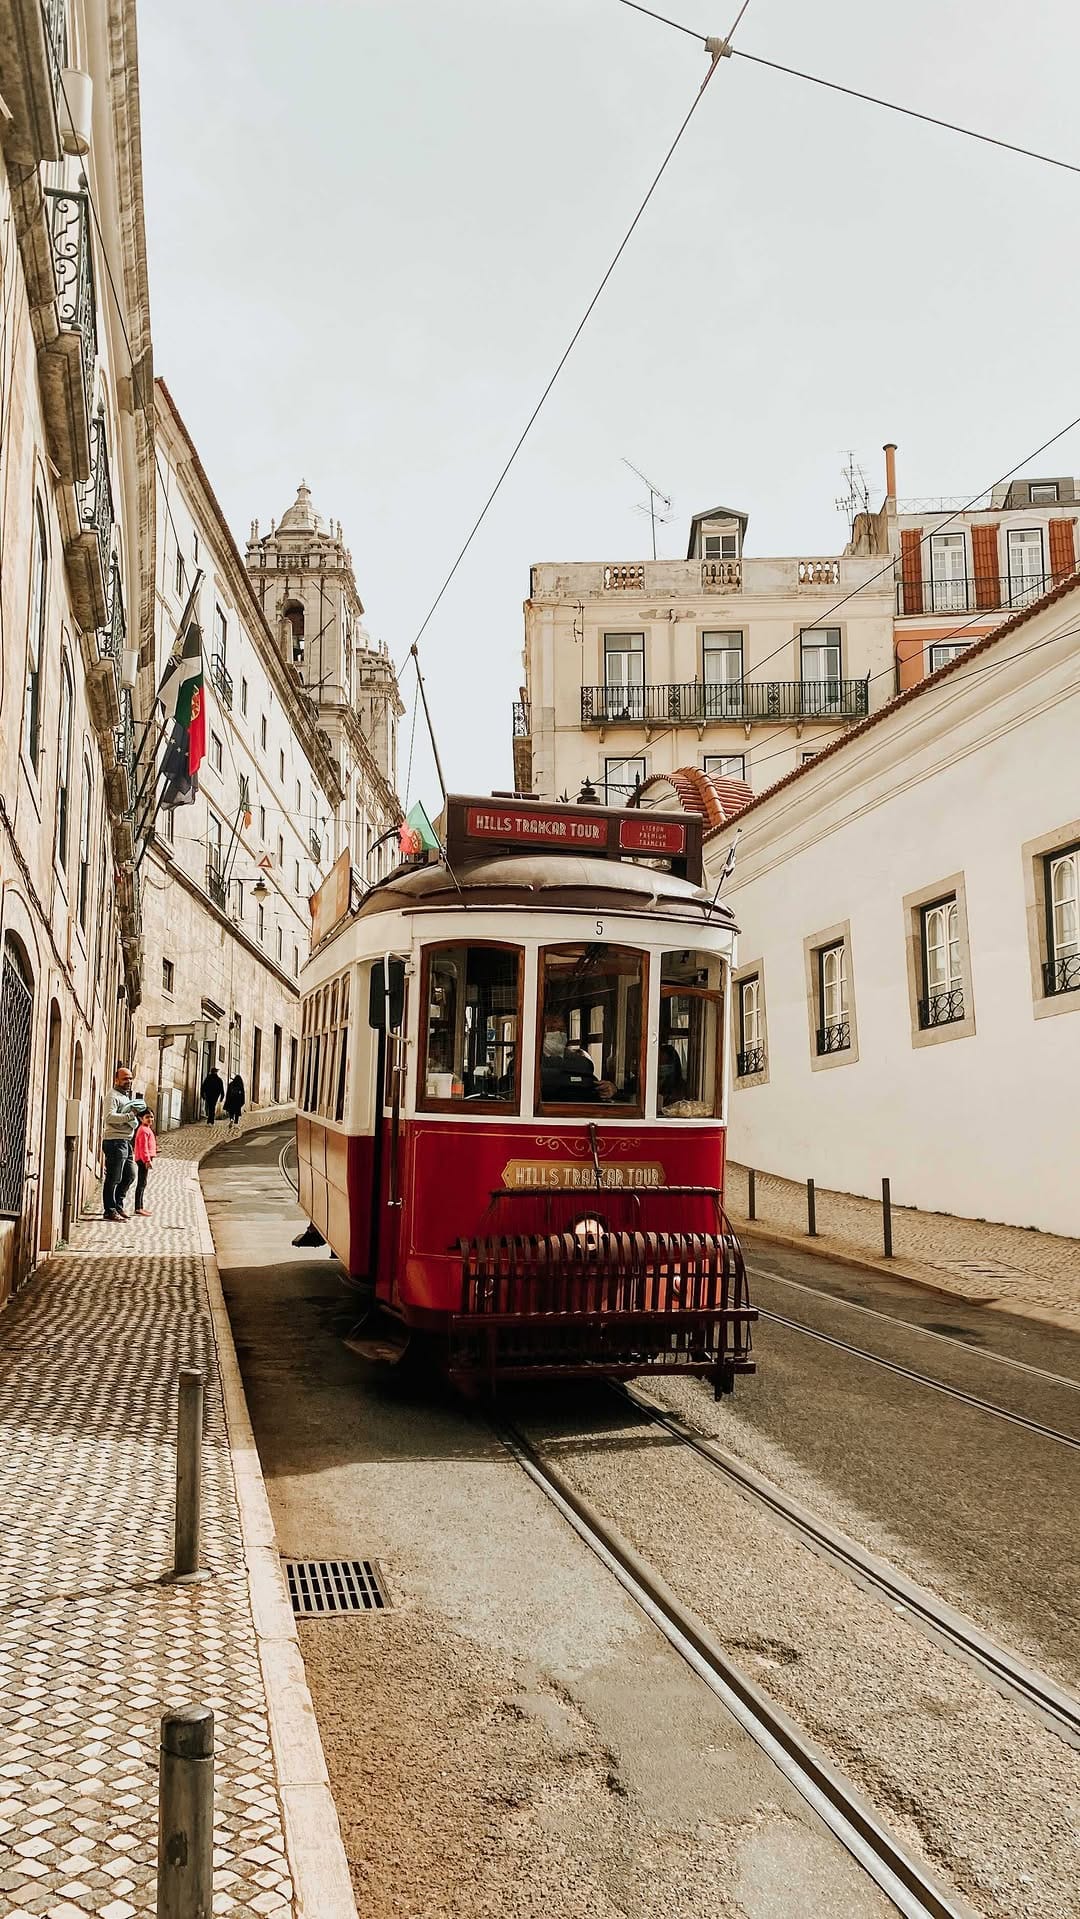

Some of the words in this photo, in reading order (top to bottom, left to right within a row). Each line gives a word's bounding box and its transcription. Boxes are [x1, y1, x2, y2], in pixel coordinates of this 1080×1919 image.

[476, 815, 512, 832] HILLS
[515, 818, 567, 836] TRAMCAR
[570, 823, 600, 839] TOUR
[595, 921, 604, 935] 5
[515, 1167, 560, 1186] HILLS
[627, 1168, 660, 1186] TOUR
